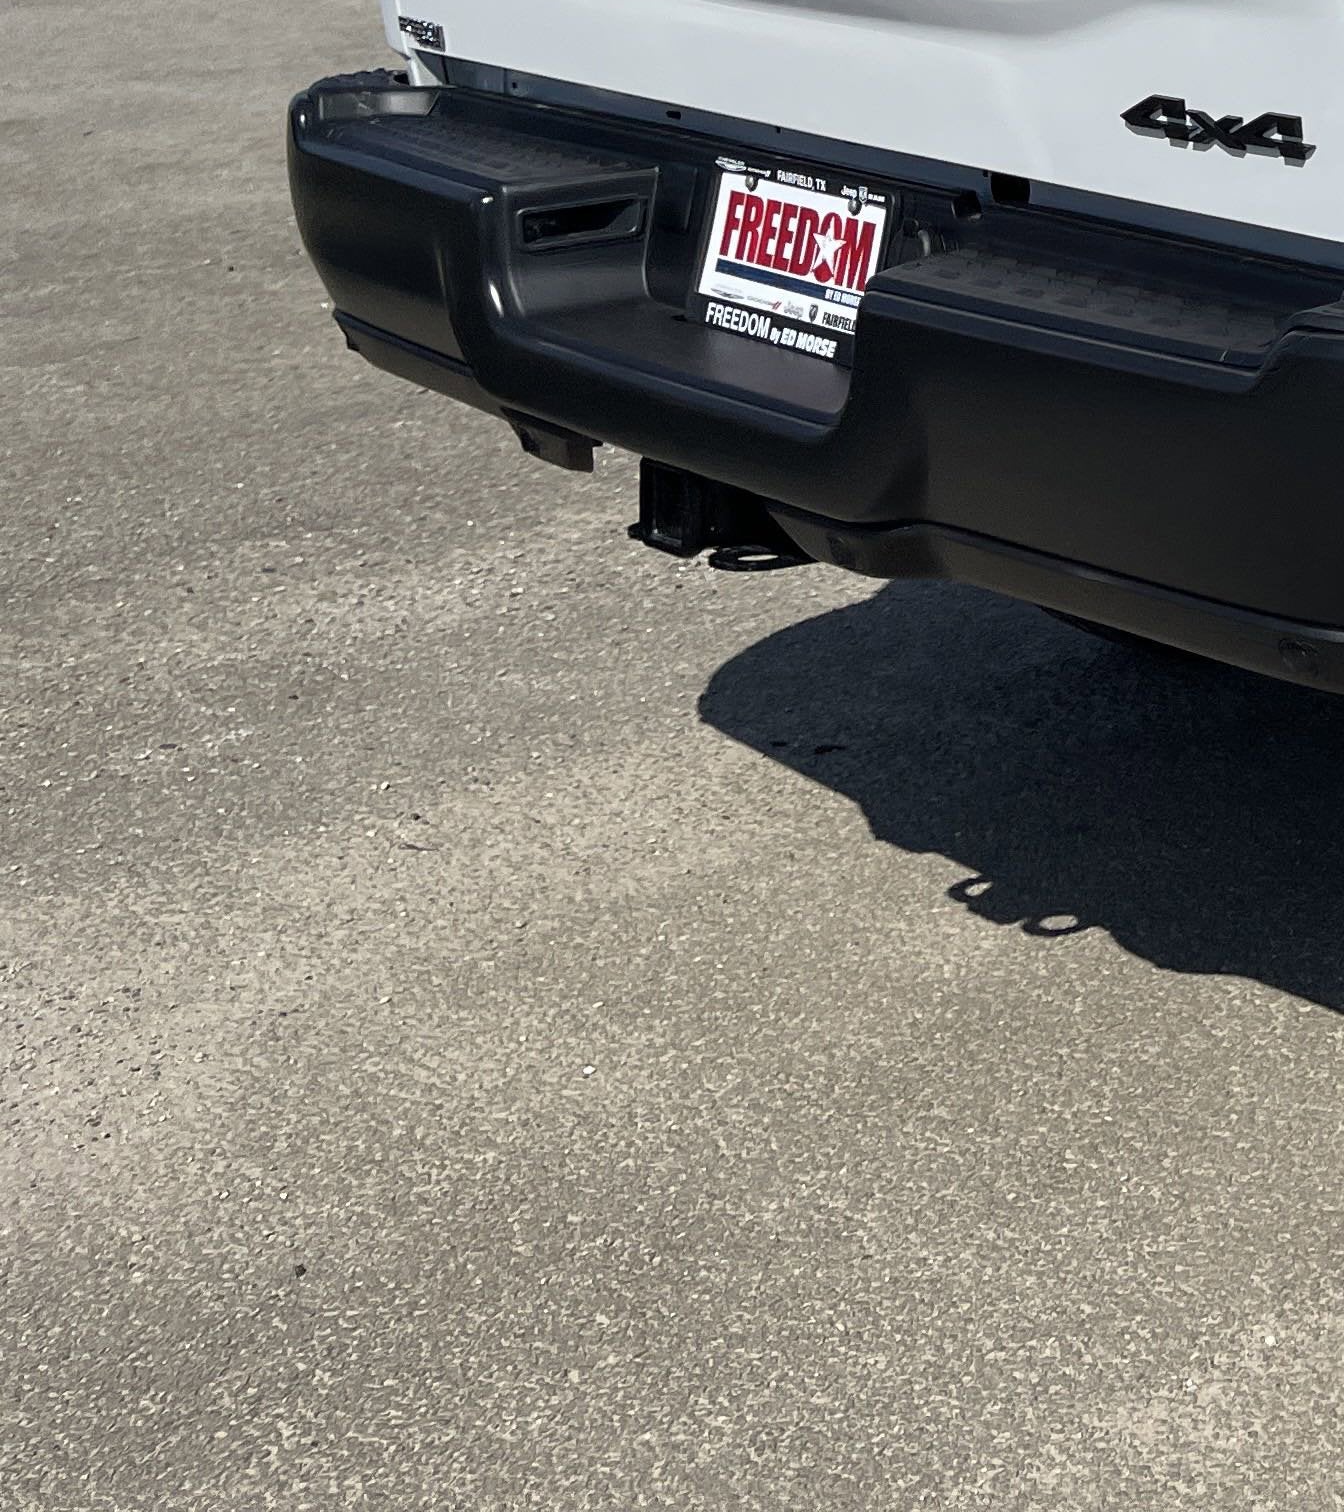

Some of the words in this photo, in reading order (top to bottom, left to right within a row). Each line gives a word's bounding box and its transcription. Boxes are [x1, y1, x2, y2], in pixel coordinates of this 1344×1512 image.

[1120, 94, 1317, 167] 4x4
[777, 170, 814, 190] FAIRFIELD,
[815, 178, 827, 192] TX
[719, 190, 876, 291] FREEDOM
[705, 302, 771, 339] FREEDOM
[770, 327, 781, 345] by
[780, 328, 797, 346] ED
[795, 332, 838, 358] MORSE
